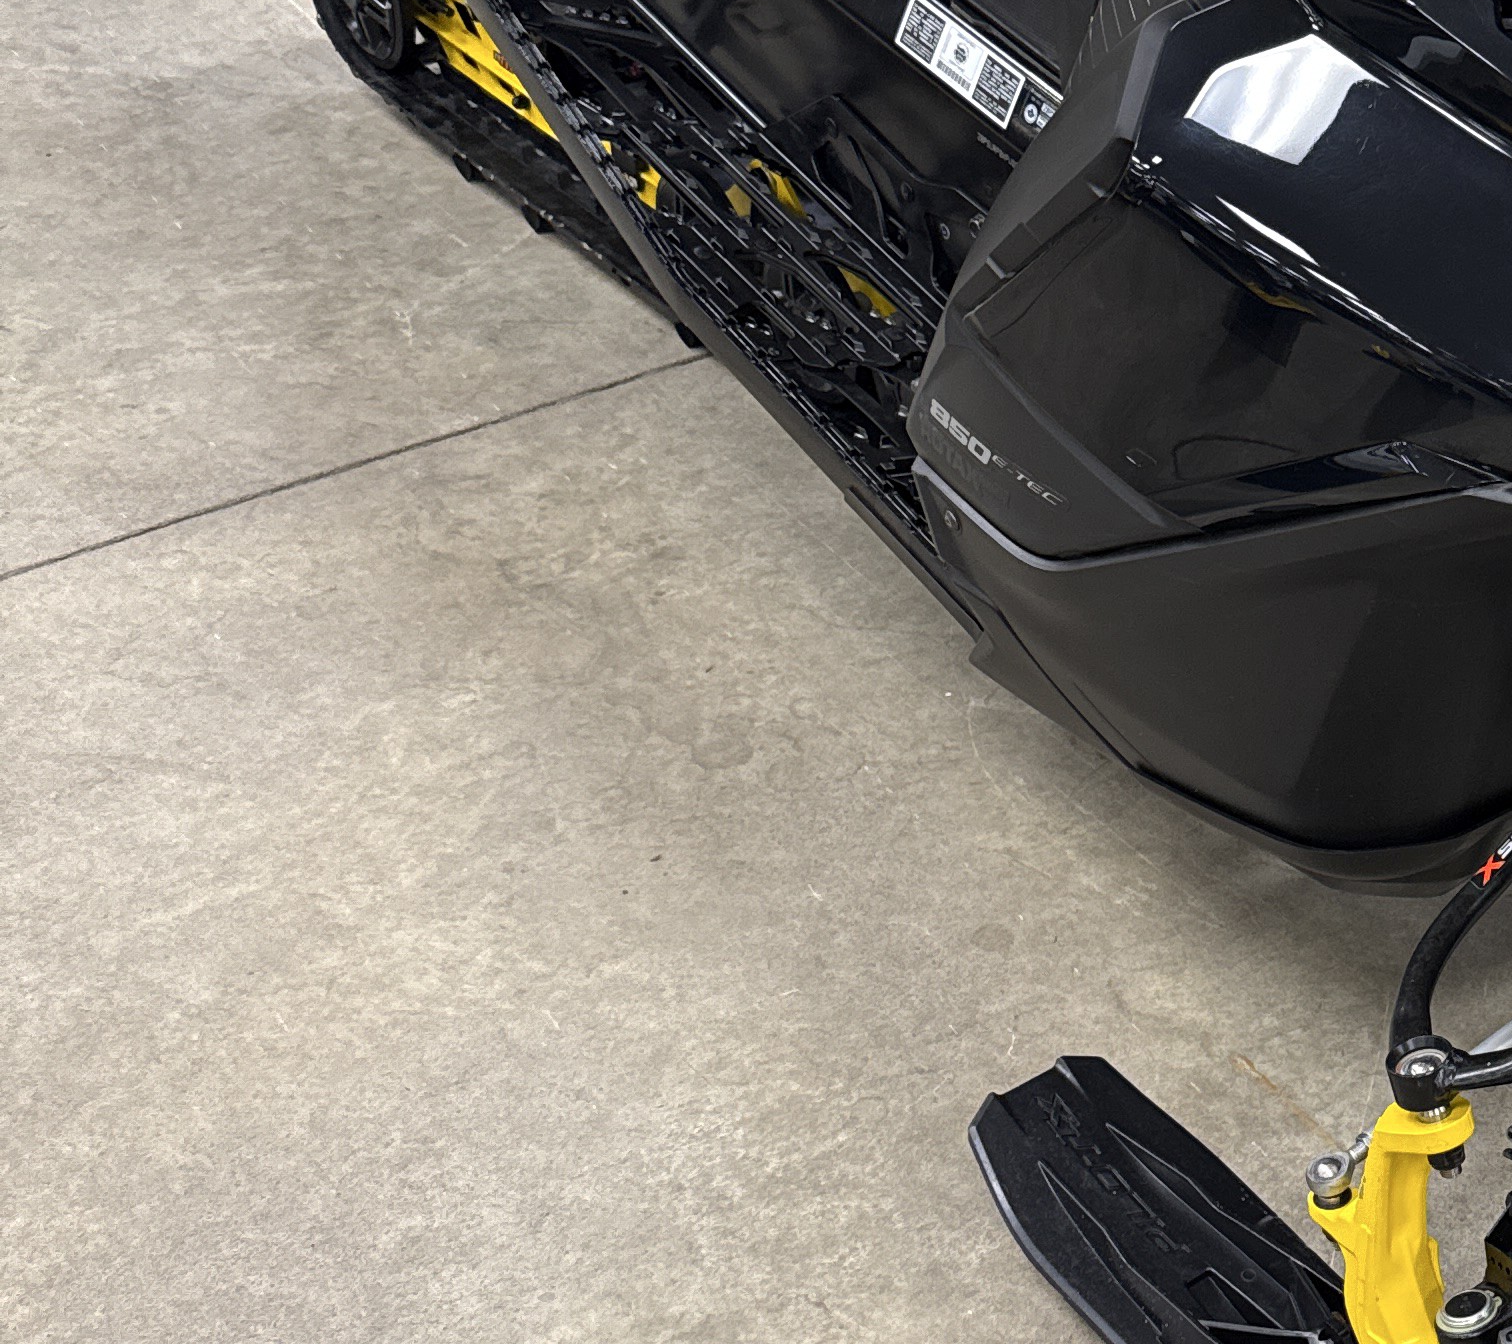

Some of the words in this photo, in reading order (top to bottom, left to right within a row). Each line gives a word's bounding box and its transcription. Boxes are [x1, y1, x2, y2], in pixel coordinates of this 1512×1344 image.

[930, 398, 992, 465] 850
[991, 454, 1064, 507] E-TEC
[1473, 854, 1506, 887] X
